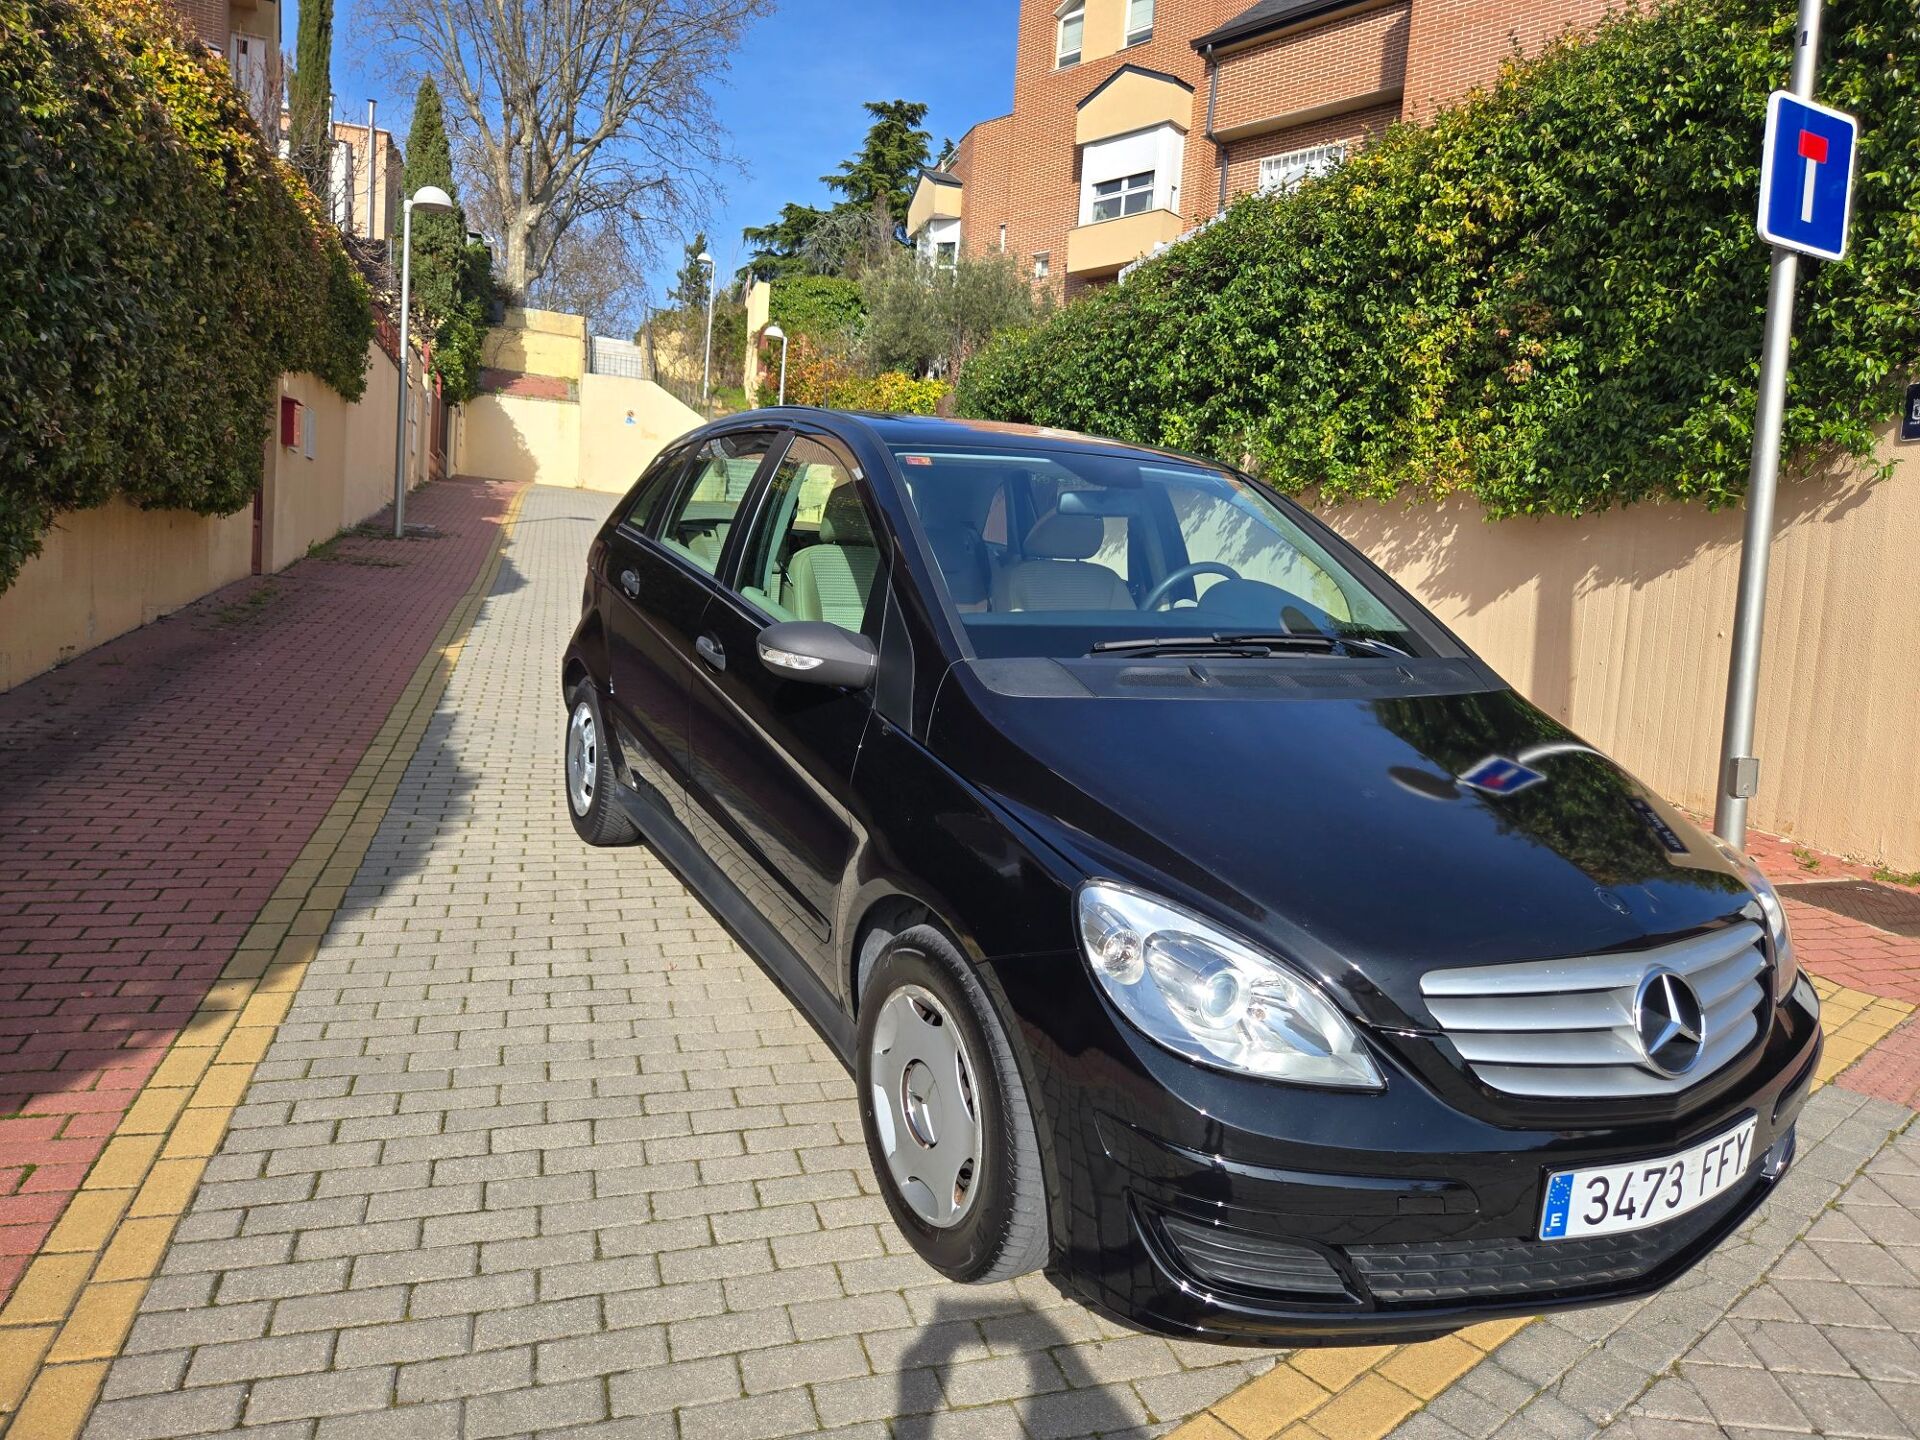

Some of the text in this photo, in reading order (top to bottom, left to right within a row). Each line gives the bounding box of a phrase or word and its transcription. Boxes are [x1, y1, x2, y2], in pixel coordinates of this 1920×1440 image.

[1582, 1127, 1751, 1226] 3473 FFY
[1550, 1212, 1563, 1227] E
